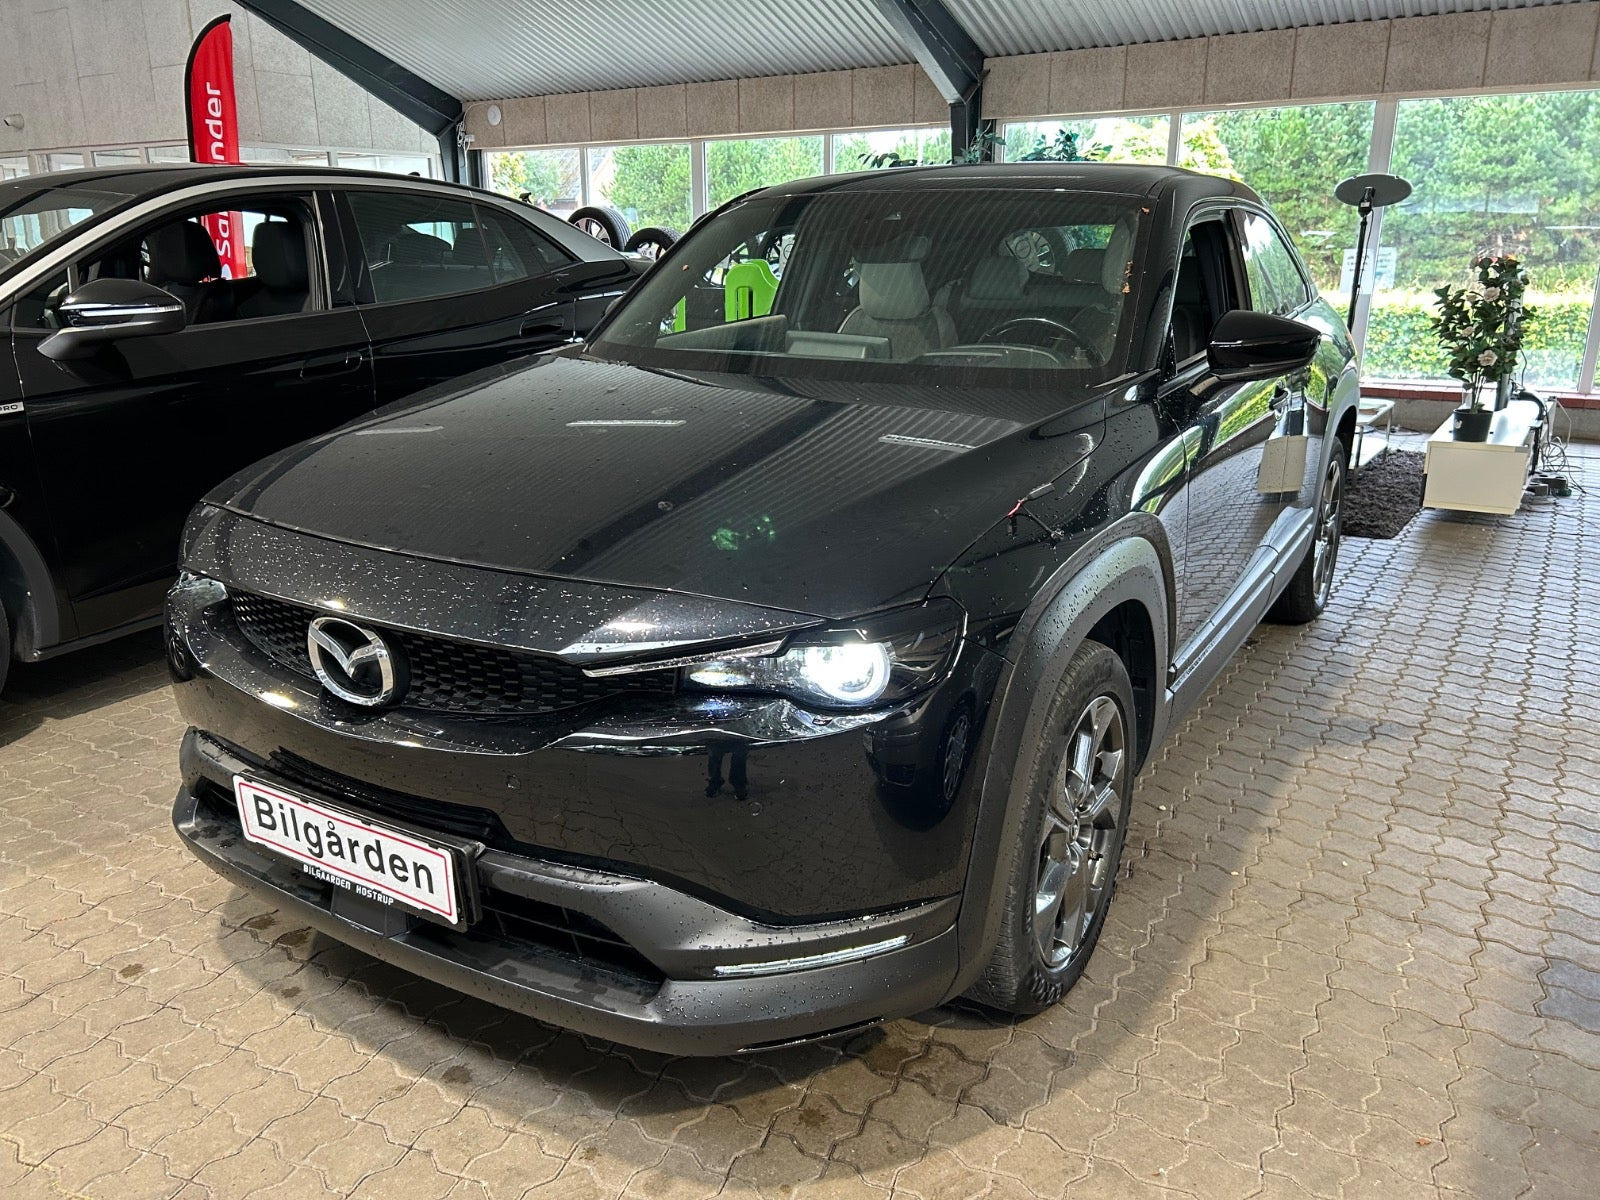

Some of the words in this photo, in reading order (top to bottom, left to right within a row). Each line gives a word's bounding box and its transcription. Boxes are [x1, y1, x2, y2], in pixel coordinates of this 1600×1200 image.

[253, 794, 434, 894] Bilgården
[303, 864, 351, 890] BILGAARDEN
[356, 885, 394, 905] HOSTRUP
